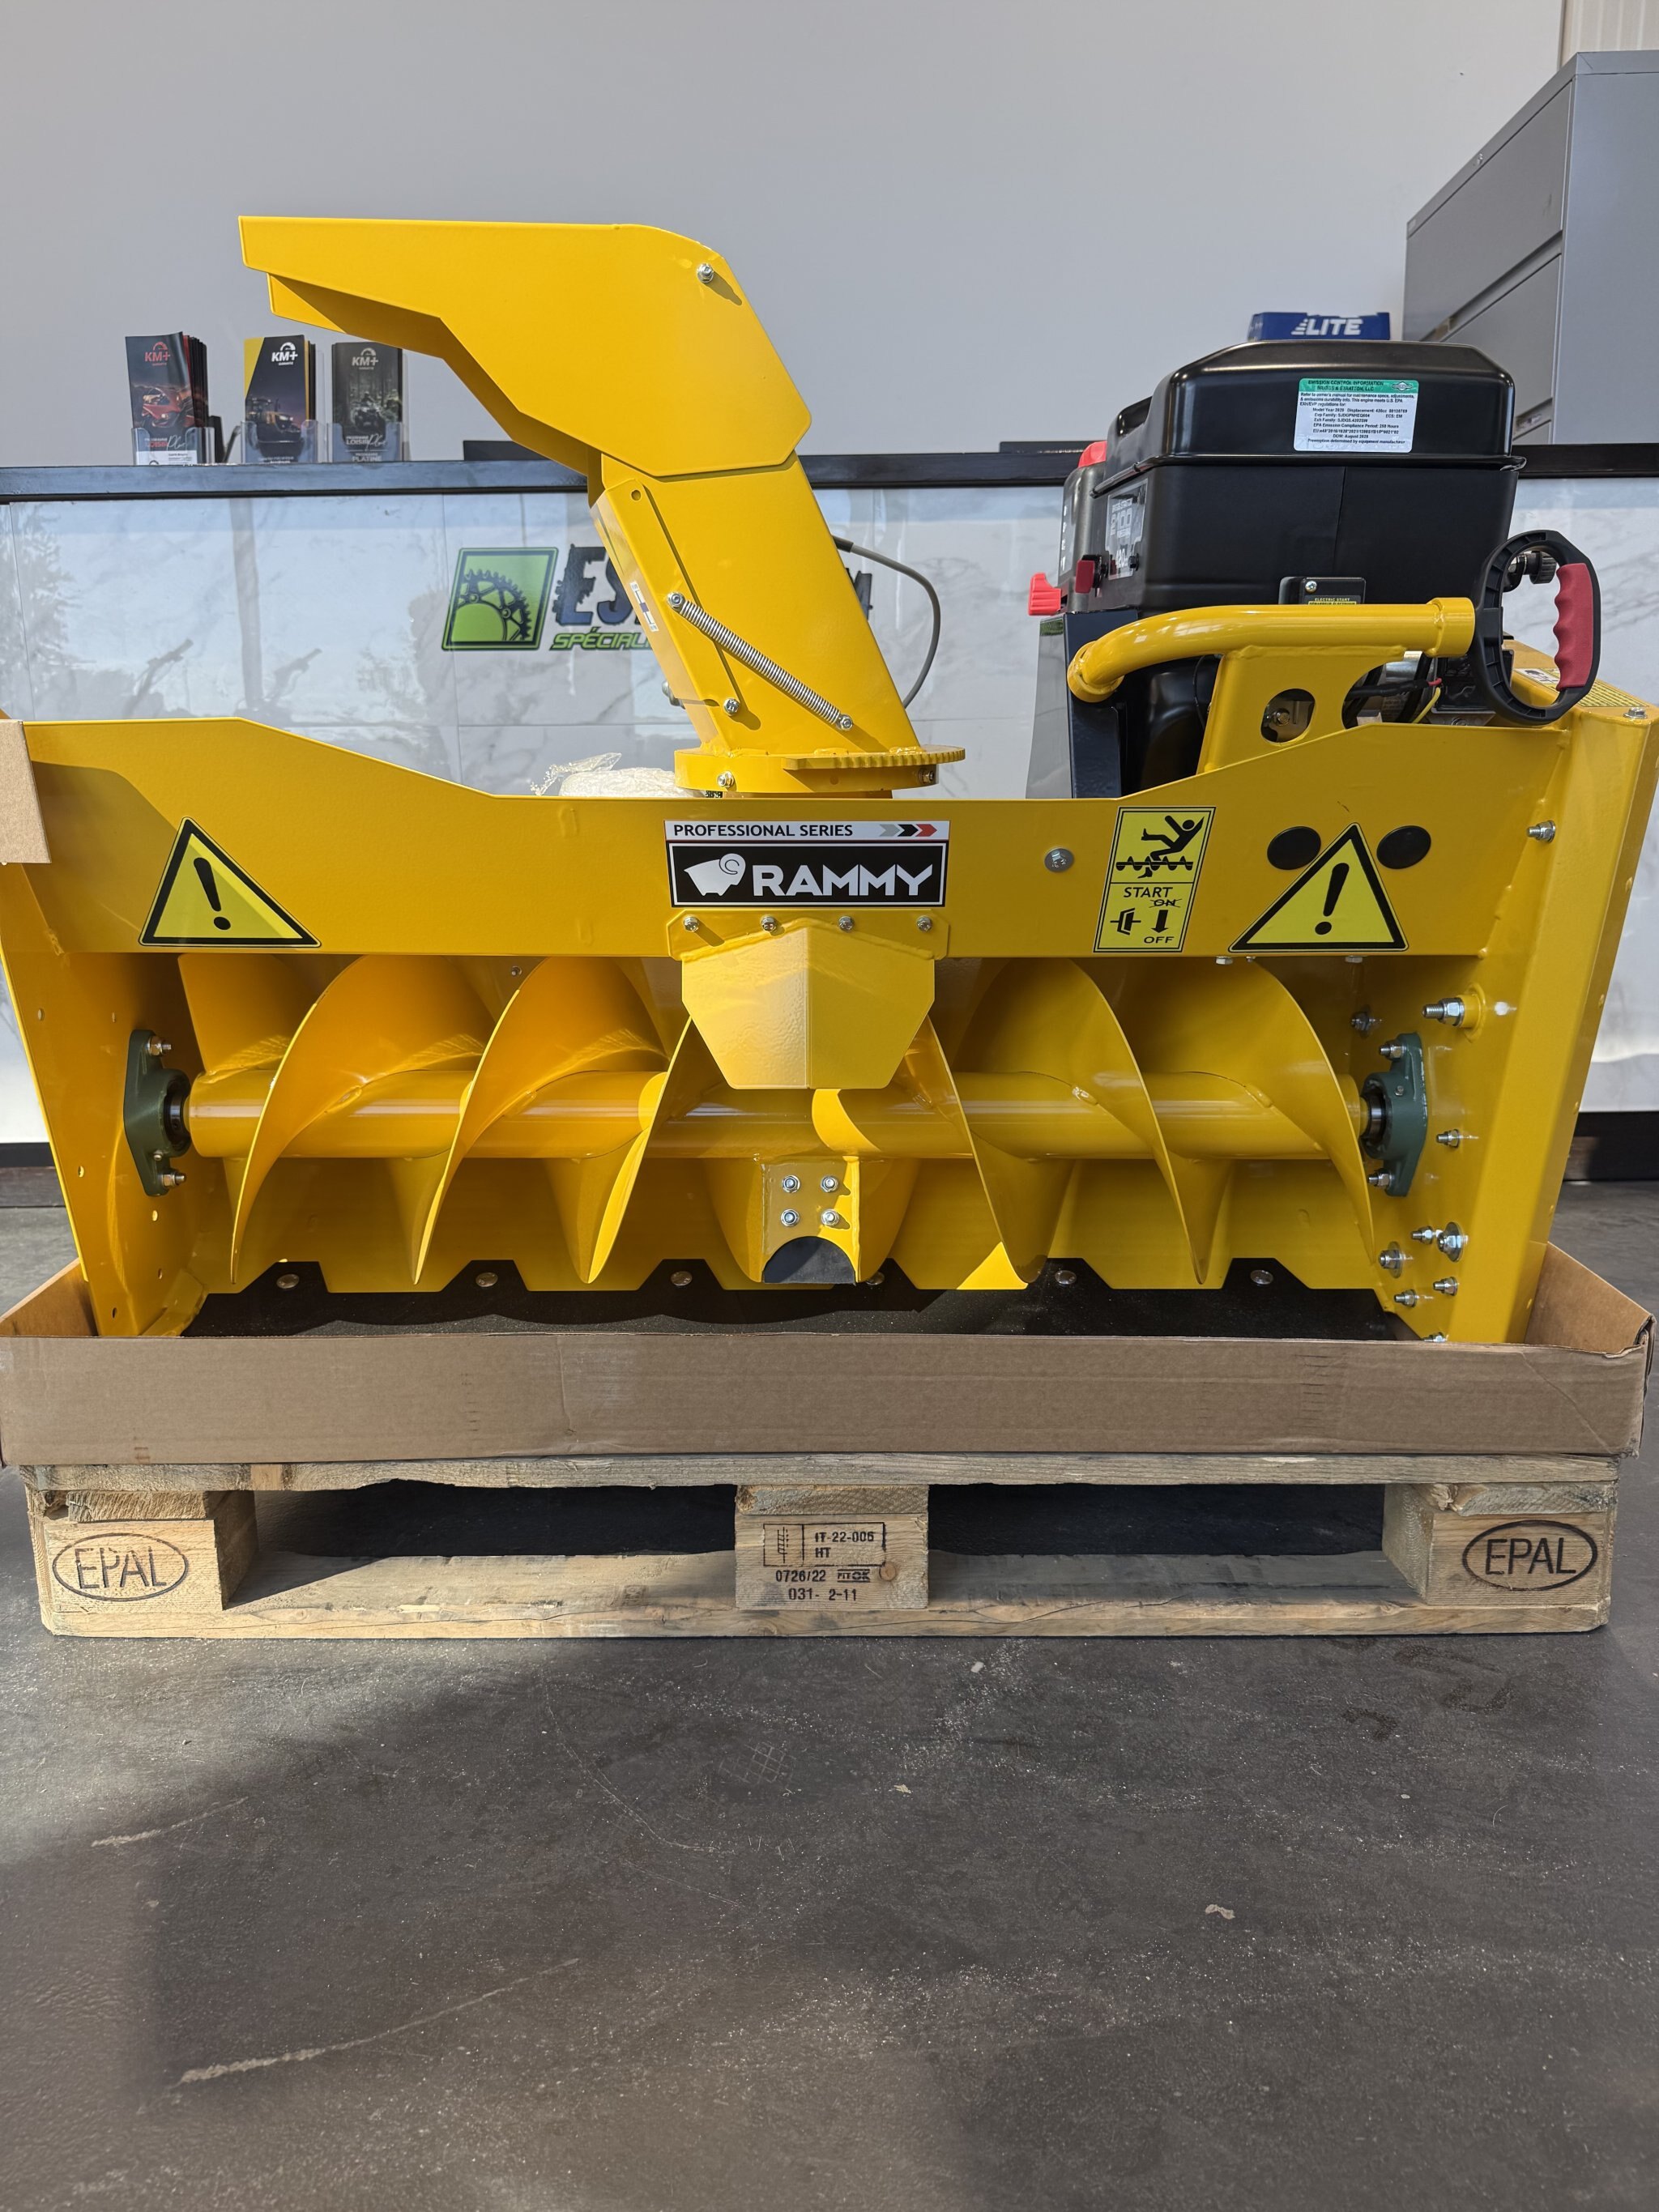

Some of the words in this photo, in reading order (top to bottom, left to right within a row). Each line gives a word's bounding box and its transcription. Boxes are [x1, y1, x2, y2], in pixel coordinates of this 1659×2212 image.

[145, 351, 170, 362] KM+
[271, 351, 298, 362] KM+
[352, 356, 379, 366] KM+
[674, 825, 795, 837] PROFESSIONAL
[800, 825, 853, 837] SERIES
[752, 864, 933, 897] RAMMY
[1124, 887, 1173, 897] START
[1153, 898, 1177, 907] ON
[815, 1547, 831, 1558] HT
[1485, 1537, 1576, 1575] EPAL
[75, 1546, 167, 1589] EPAL
[775, 1570, 826, 1583] 0726/22
